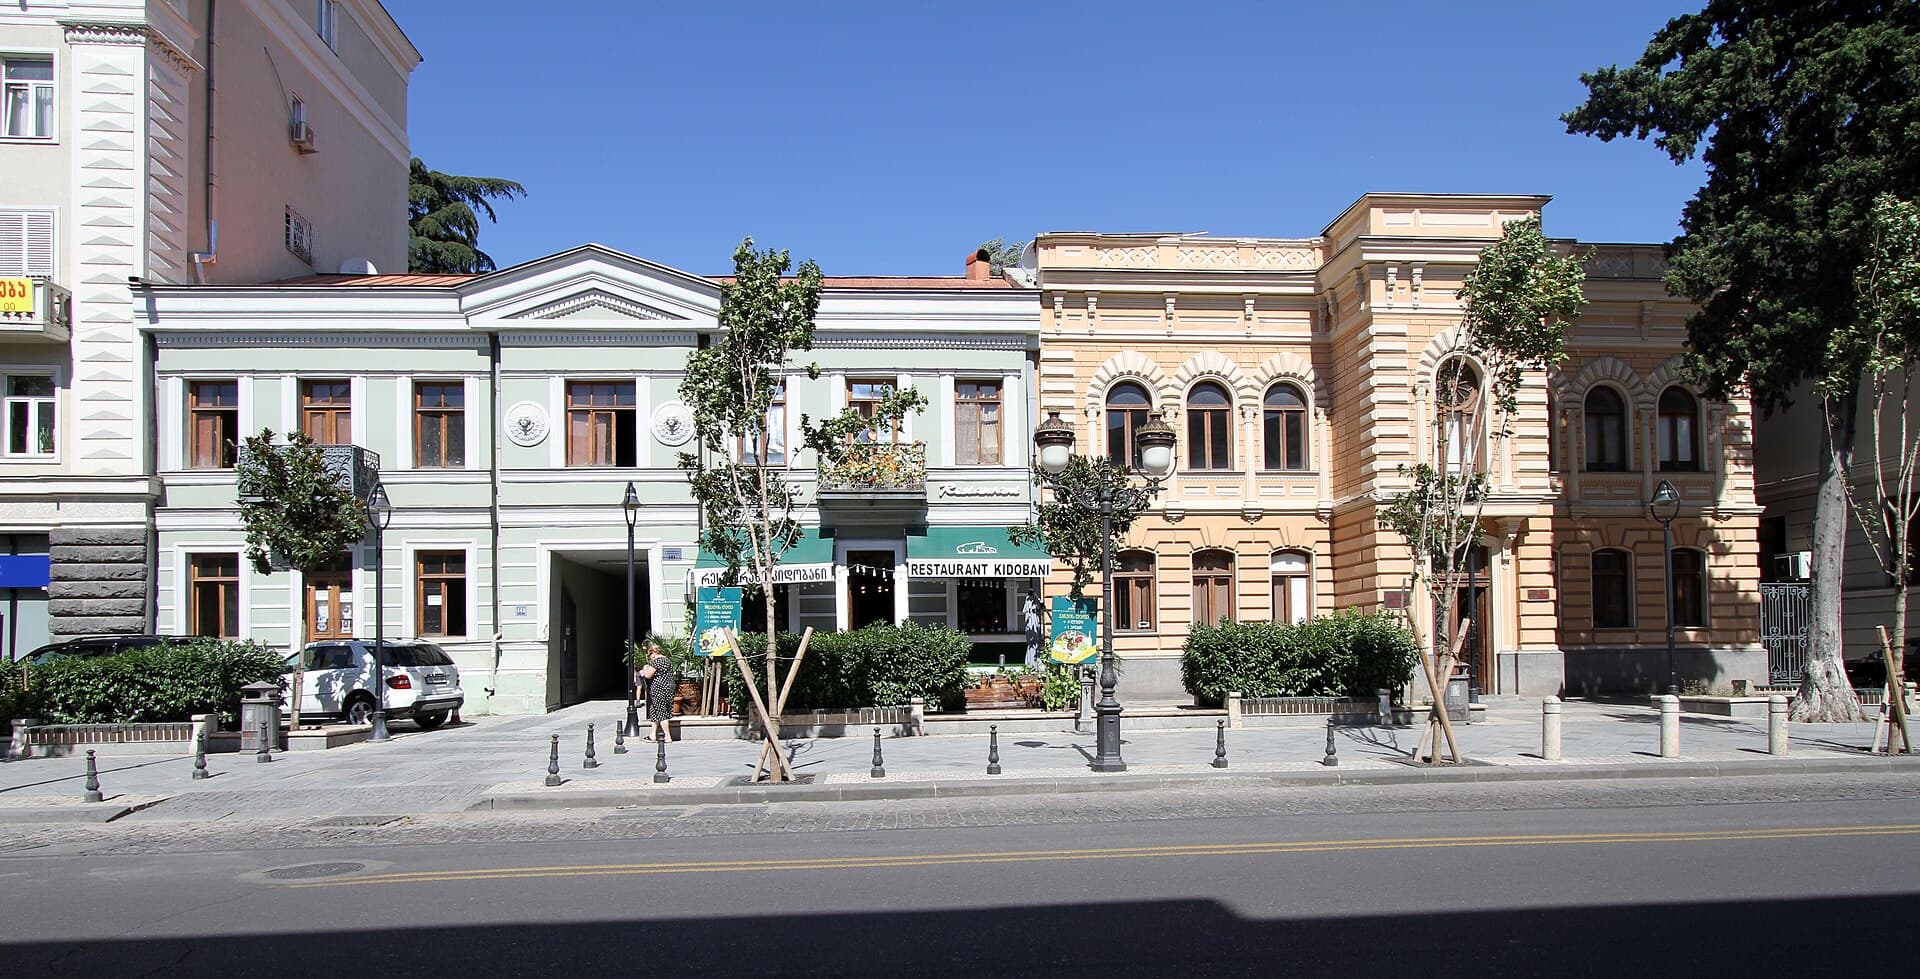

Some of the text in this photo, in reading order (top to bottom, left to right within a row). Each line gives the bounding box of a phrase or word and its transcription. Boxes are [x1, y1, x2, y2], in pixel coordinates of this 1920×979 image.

[772, 568, 827, 582] კიდობანი
[911, 563, 1050, 576] RESTAURANT KIDOBANI
